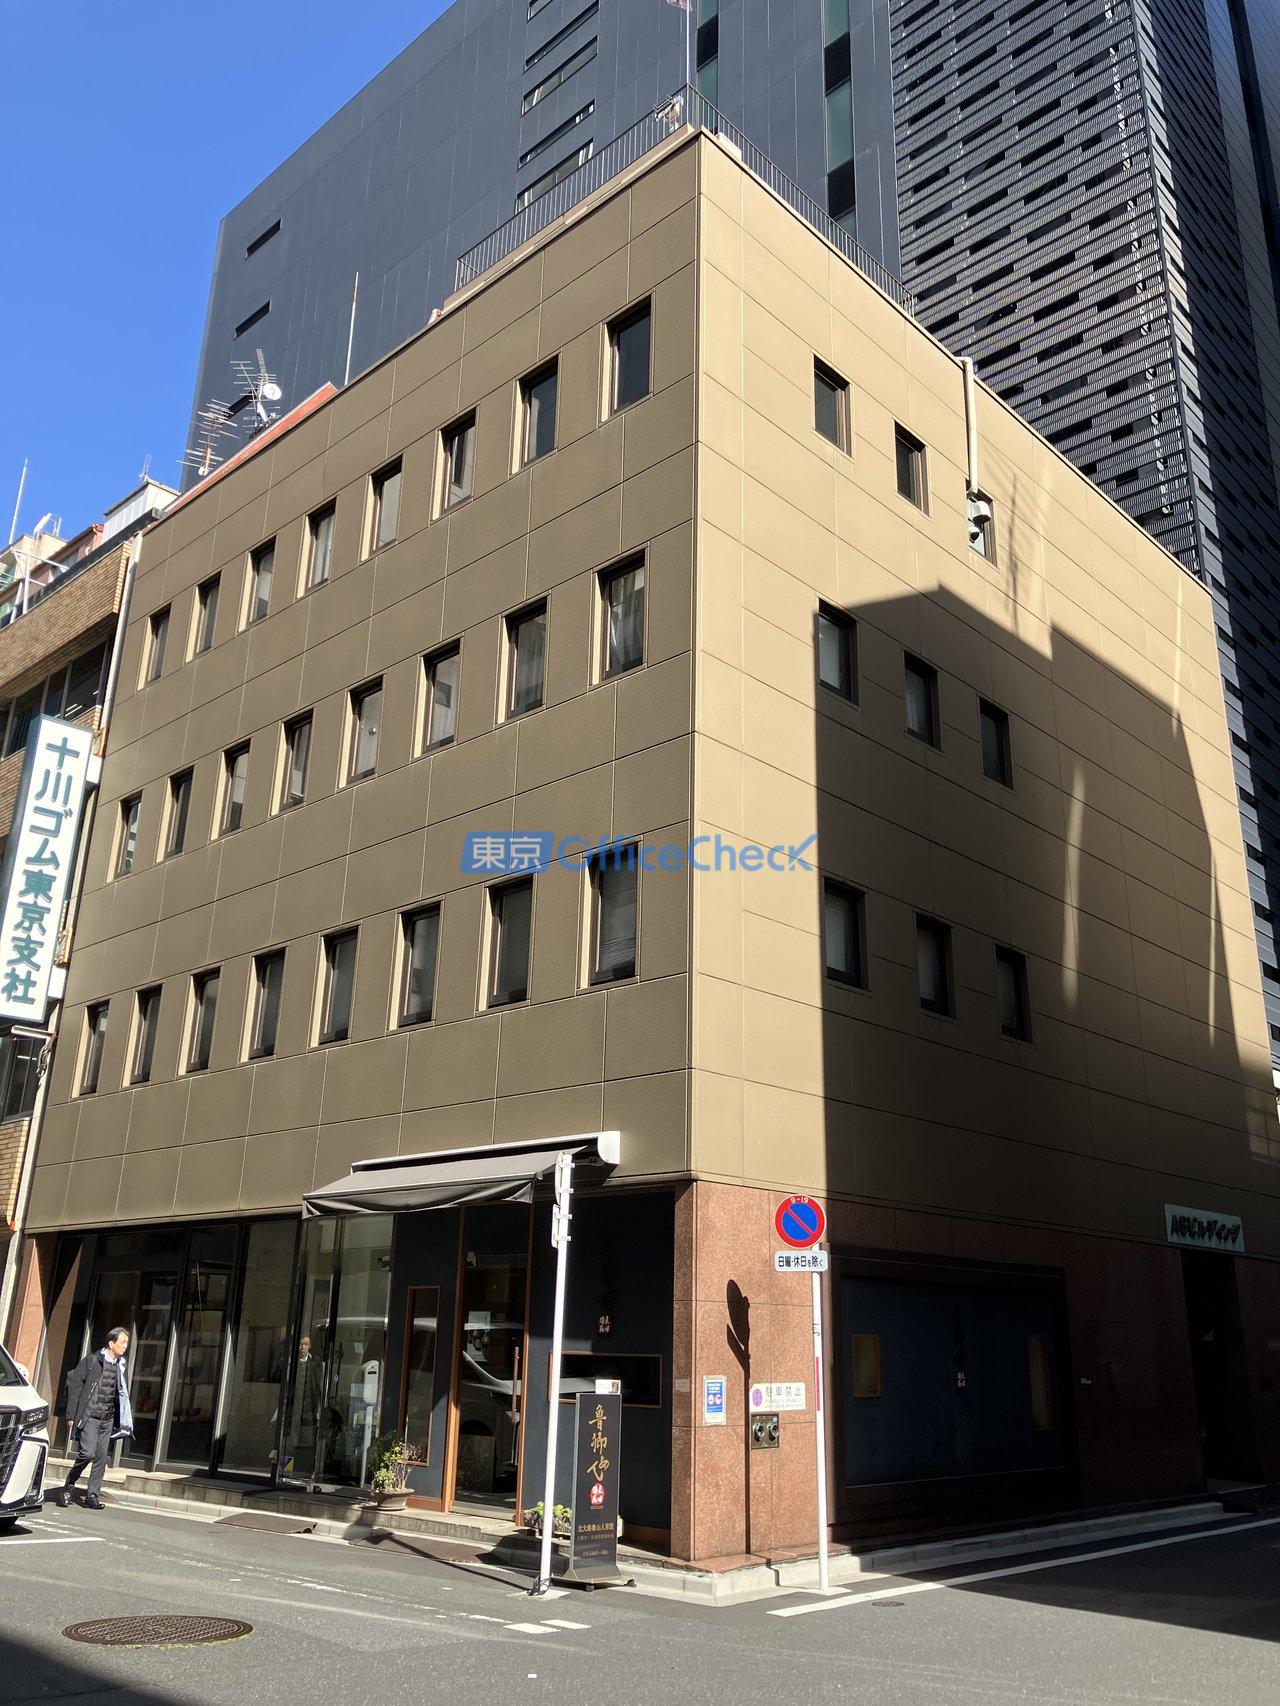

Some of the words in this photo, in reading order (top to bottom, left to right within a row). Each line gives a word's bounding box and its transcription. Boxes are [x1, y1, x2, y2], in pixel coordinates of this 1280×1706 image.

[1, 736, 80, 1005] 十川ゴム東京支社
[778, 1255, 824, 1268] 日曜・休日を除く
[765, 1385, 802, 1397] 駐車禁止
